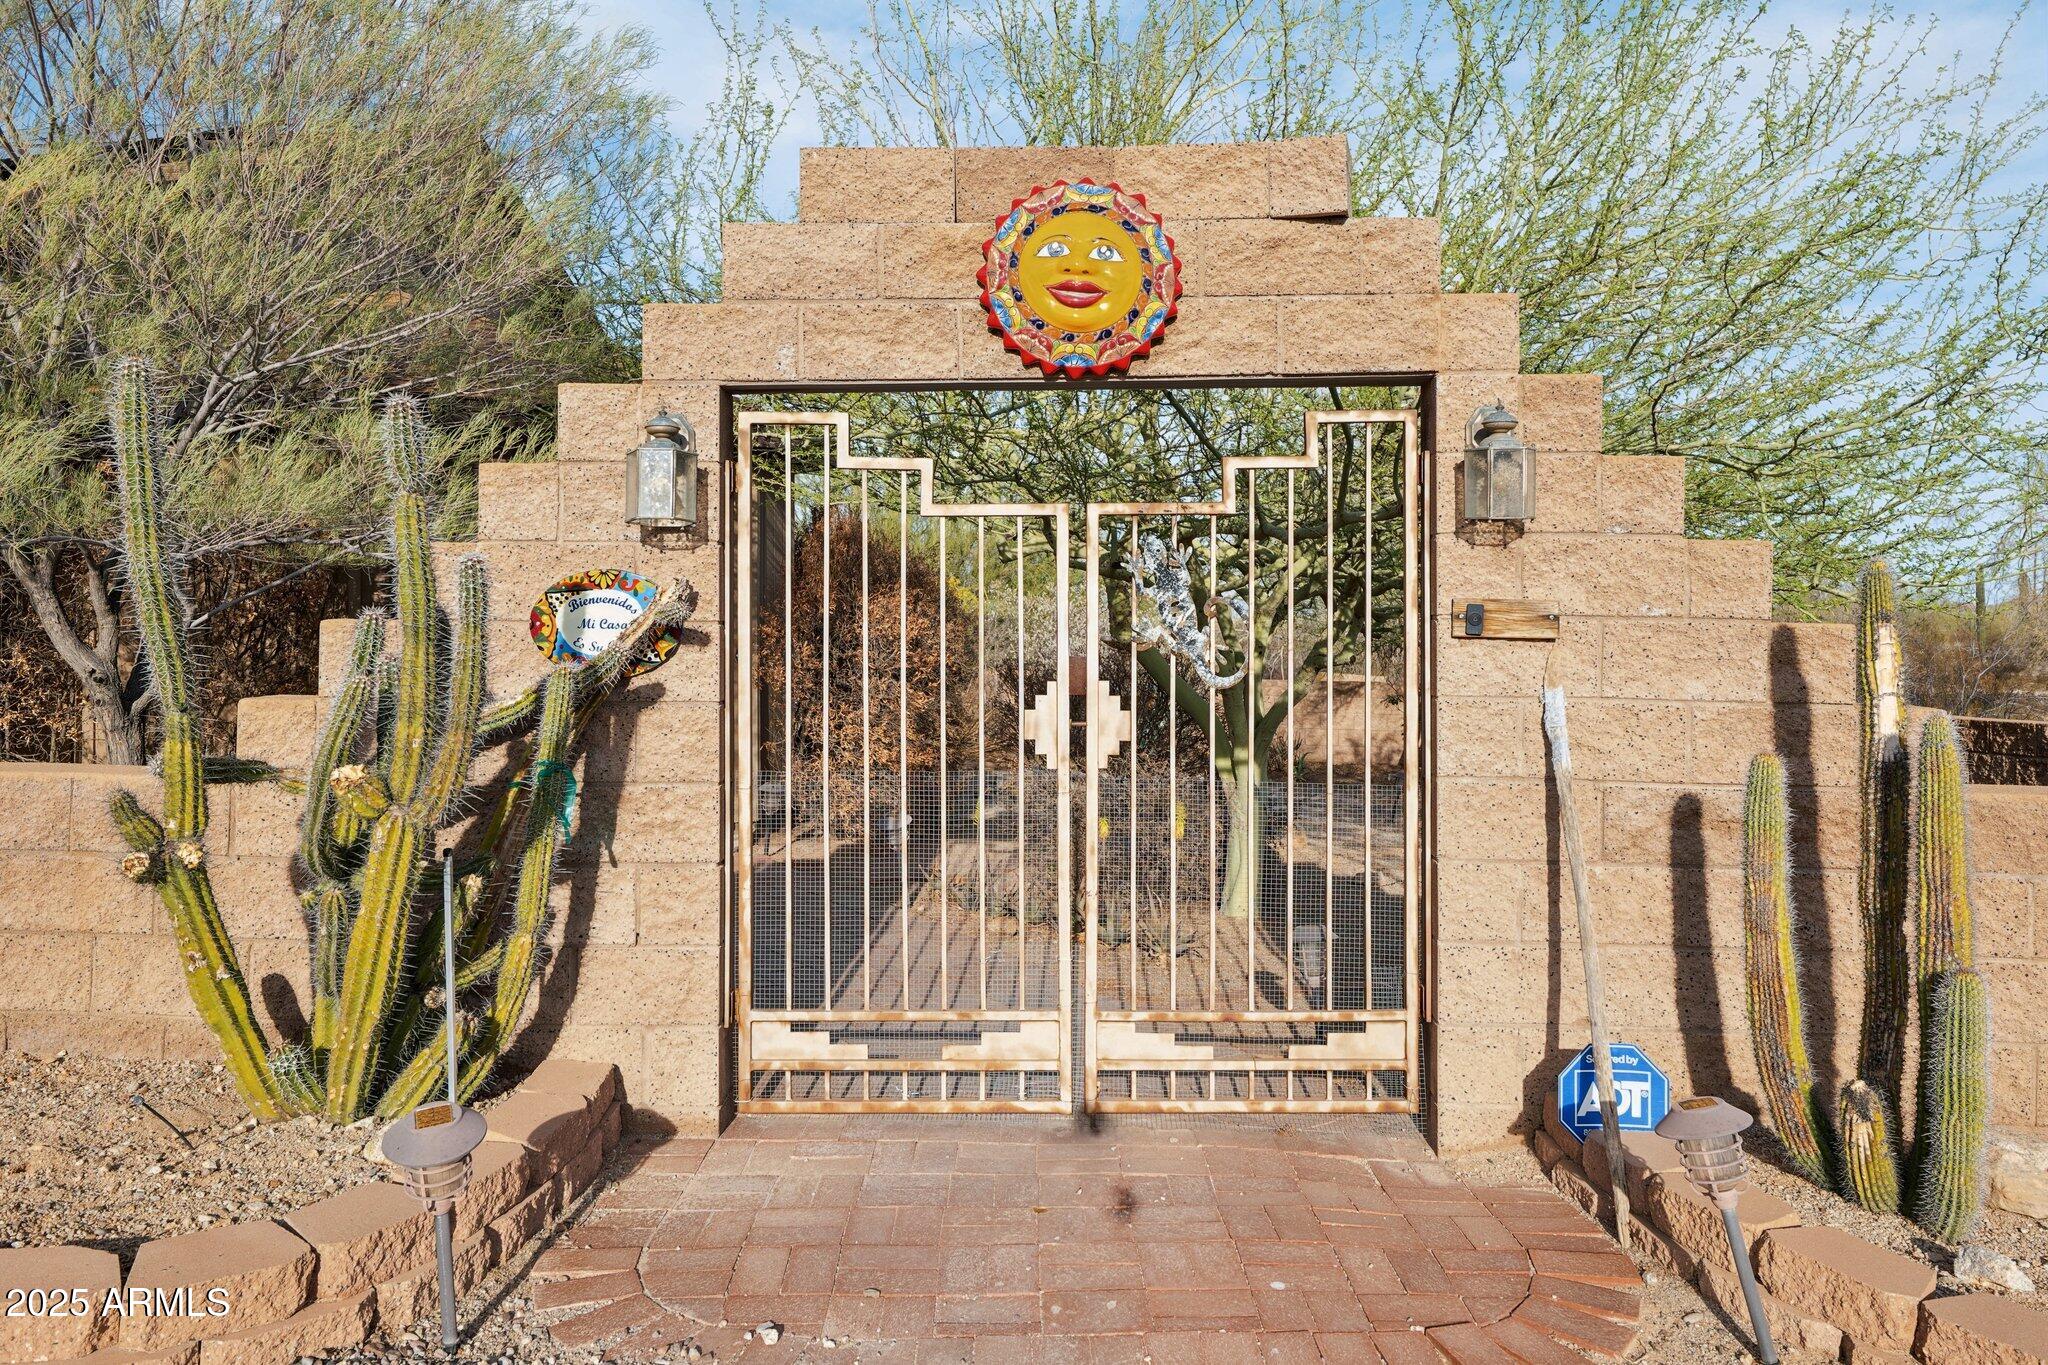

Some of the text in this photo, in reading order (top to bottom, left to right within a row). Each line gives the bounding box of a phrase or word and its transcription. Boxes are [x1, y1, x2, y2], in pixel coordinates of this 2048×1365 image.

[567, 596, 637, 615] Bienvenidos
[577, 618, 595, 629] Mi
[573, 637, 585, 648] Es
[588, 641, 604, 652] Su
[1626, 1055, 1639, 1066] by
